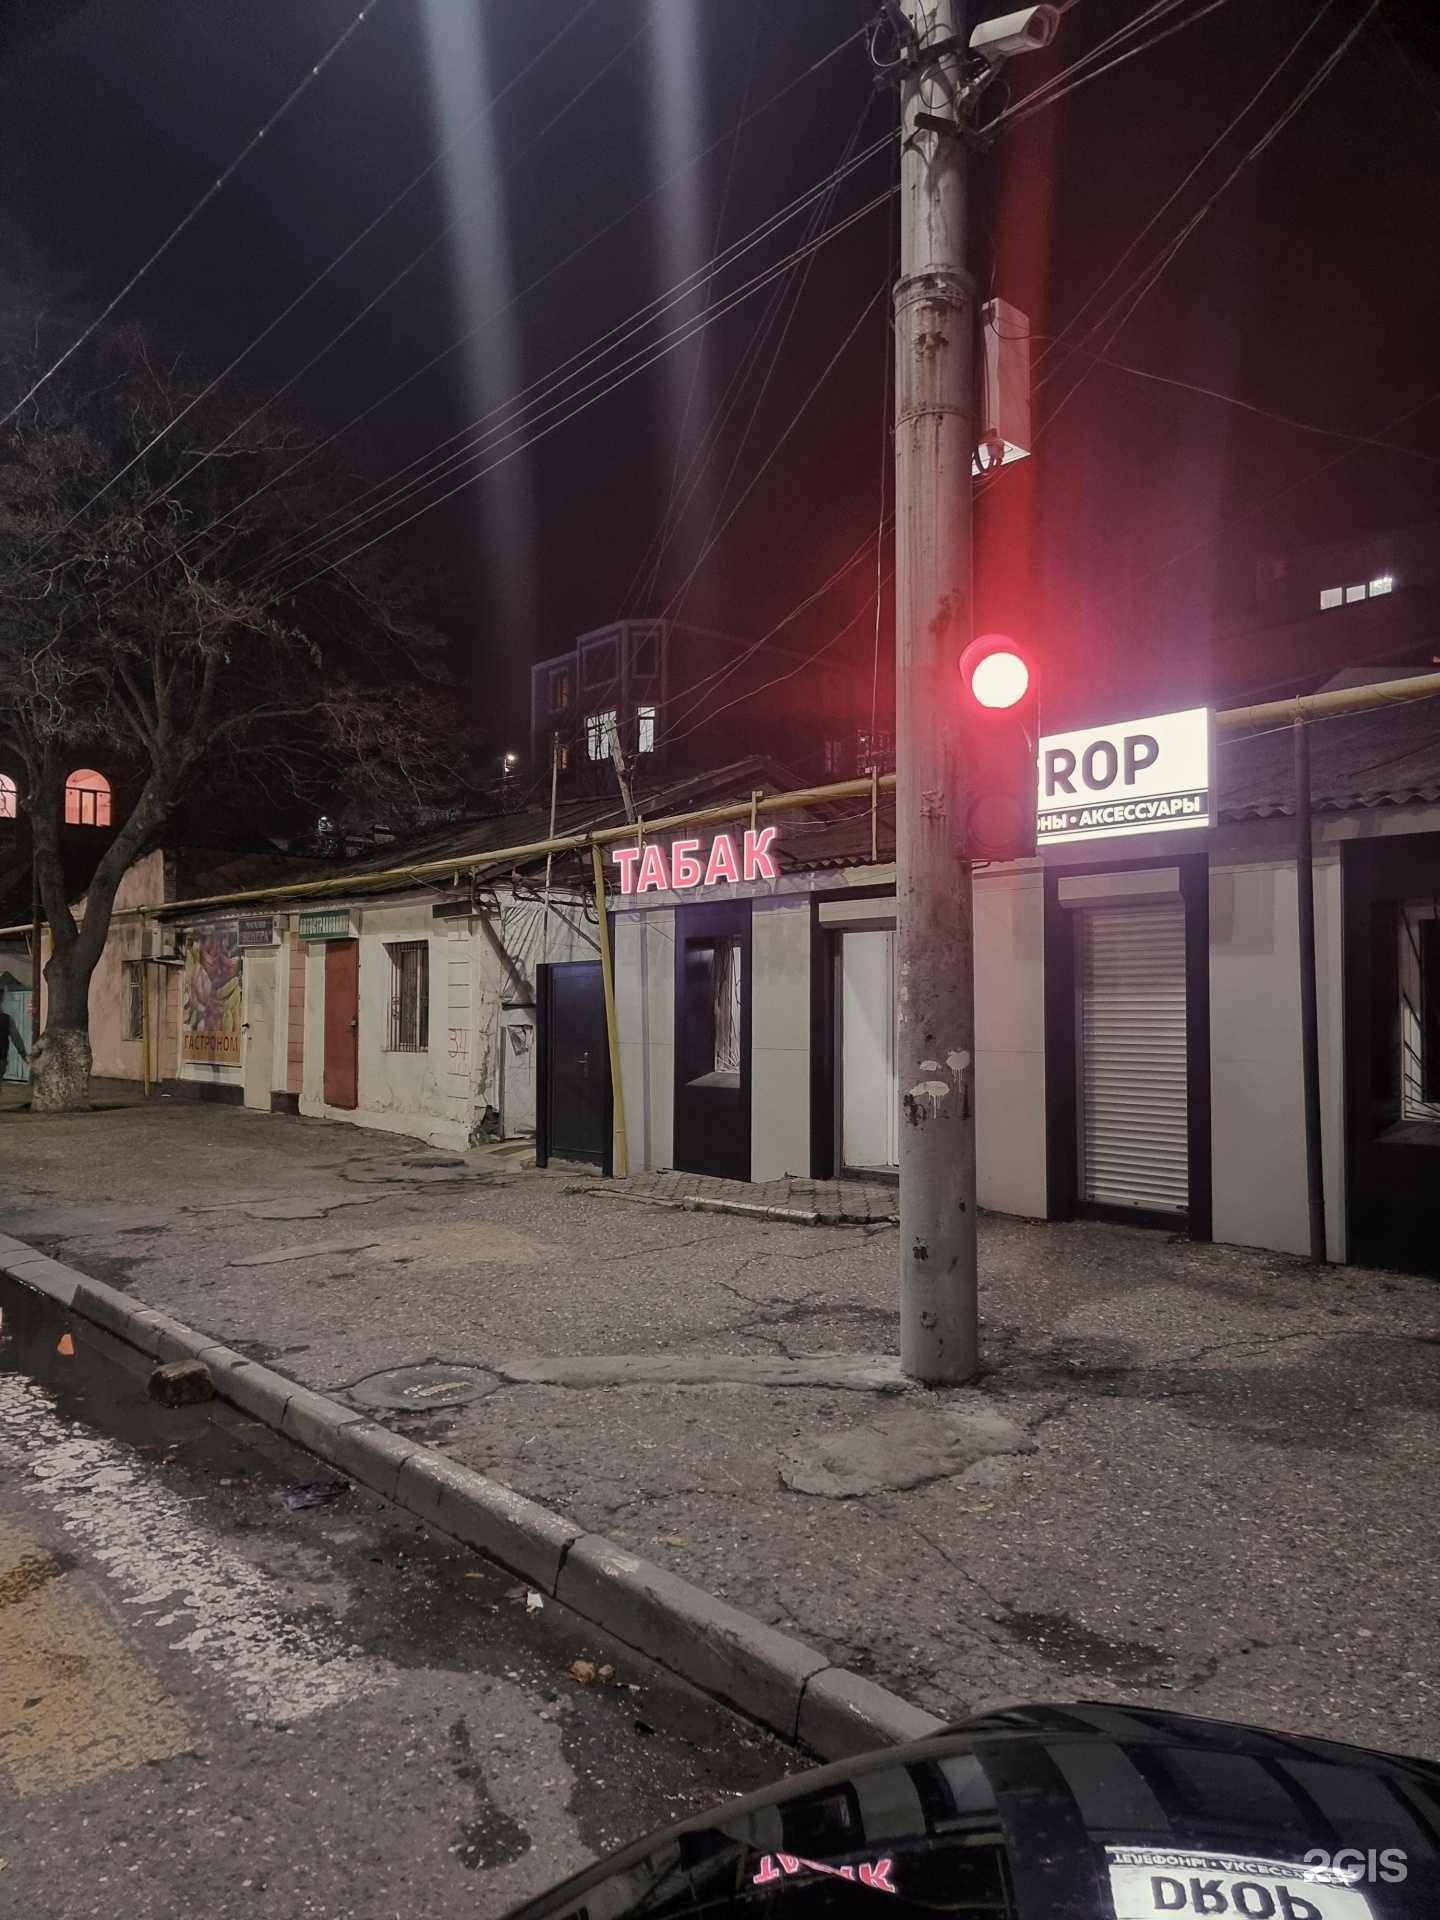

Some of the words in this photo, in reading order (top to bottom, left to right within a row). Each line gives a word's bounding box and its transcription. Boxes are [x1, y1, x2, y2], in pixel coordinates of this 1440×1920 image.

[1037, 734, 1159, 796] ROP
[1079, 796, 1201, 826] АКСЕССУАРЫ
[612, 827, 776, 894] ТАБАК
[184, 1035, 239, 1052] ГАСТРОНОМ
